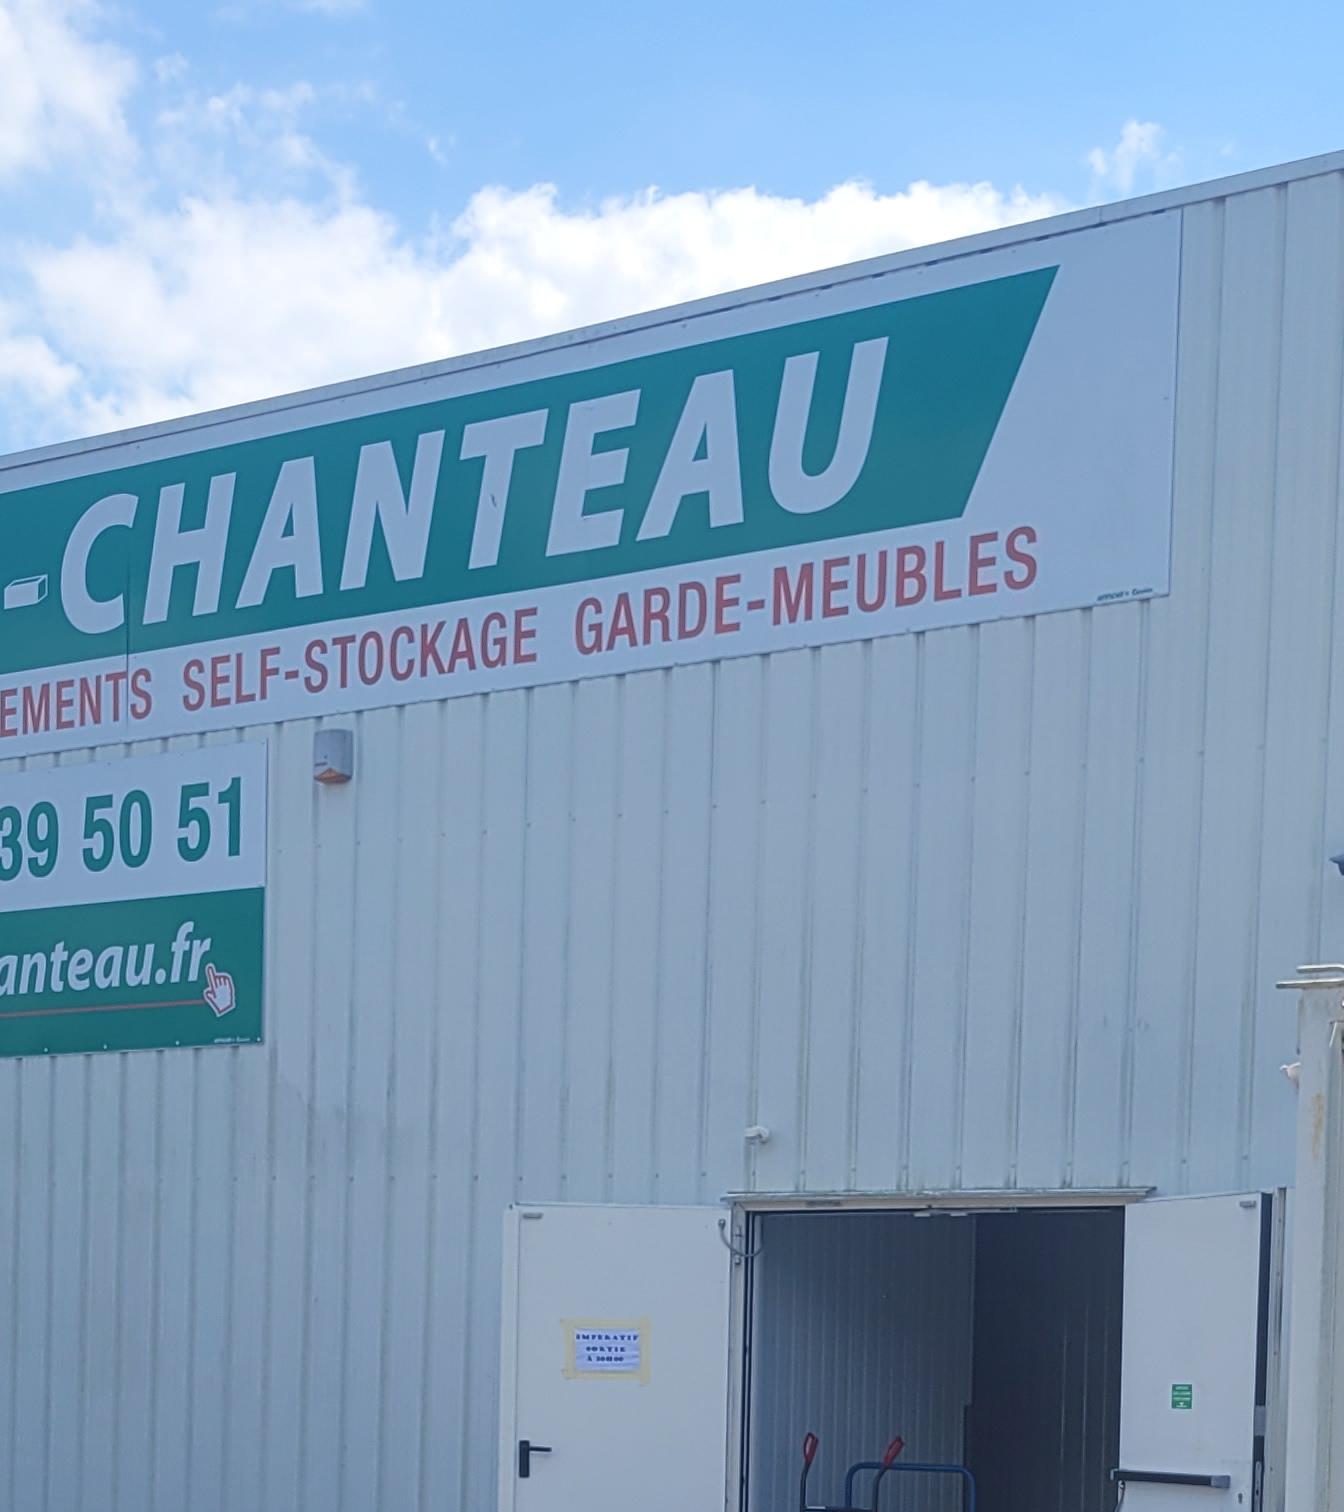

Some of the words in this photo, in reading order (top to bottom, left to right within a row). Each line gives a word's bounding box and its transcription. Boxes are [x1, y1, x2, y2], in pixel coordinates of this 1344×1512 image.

[181, 606, 538, 711] SELF-STOCKAGE
[575, 526, 1039, 656] GARDE-MEUBLES
[82, 789, 153, 873] 50
[176, 776, 241, 863] 51
